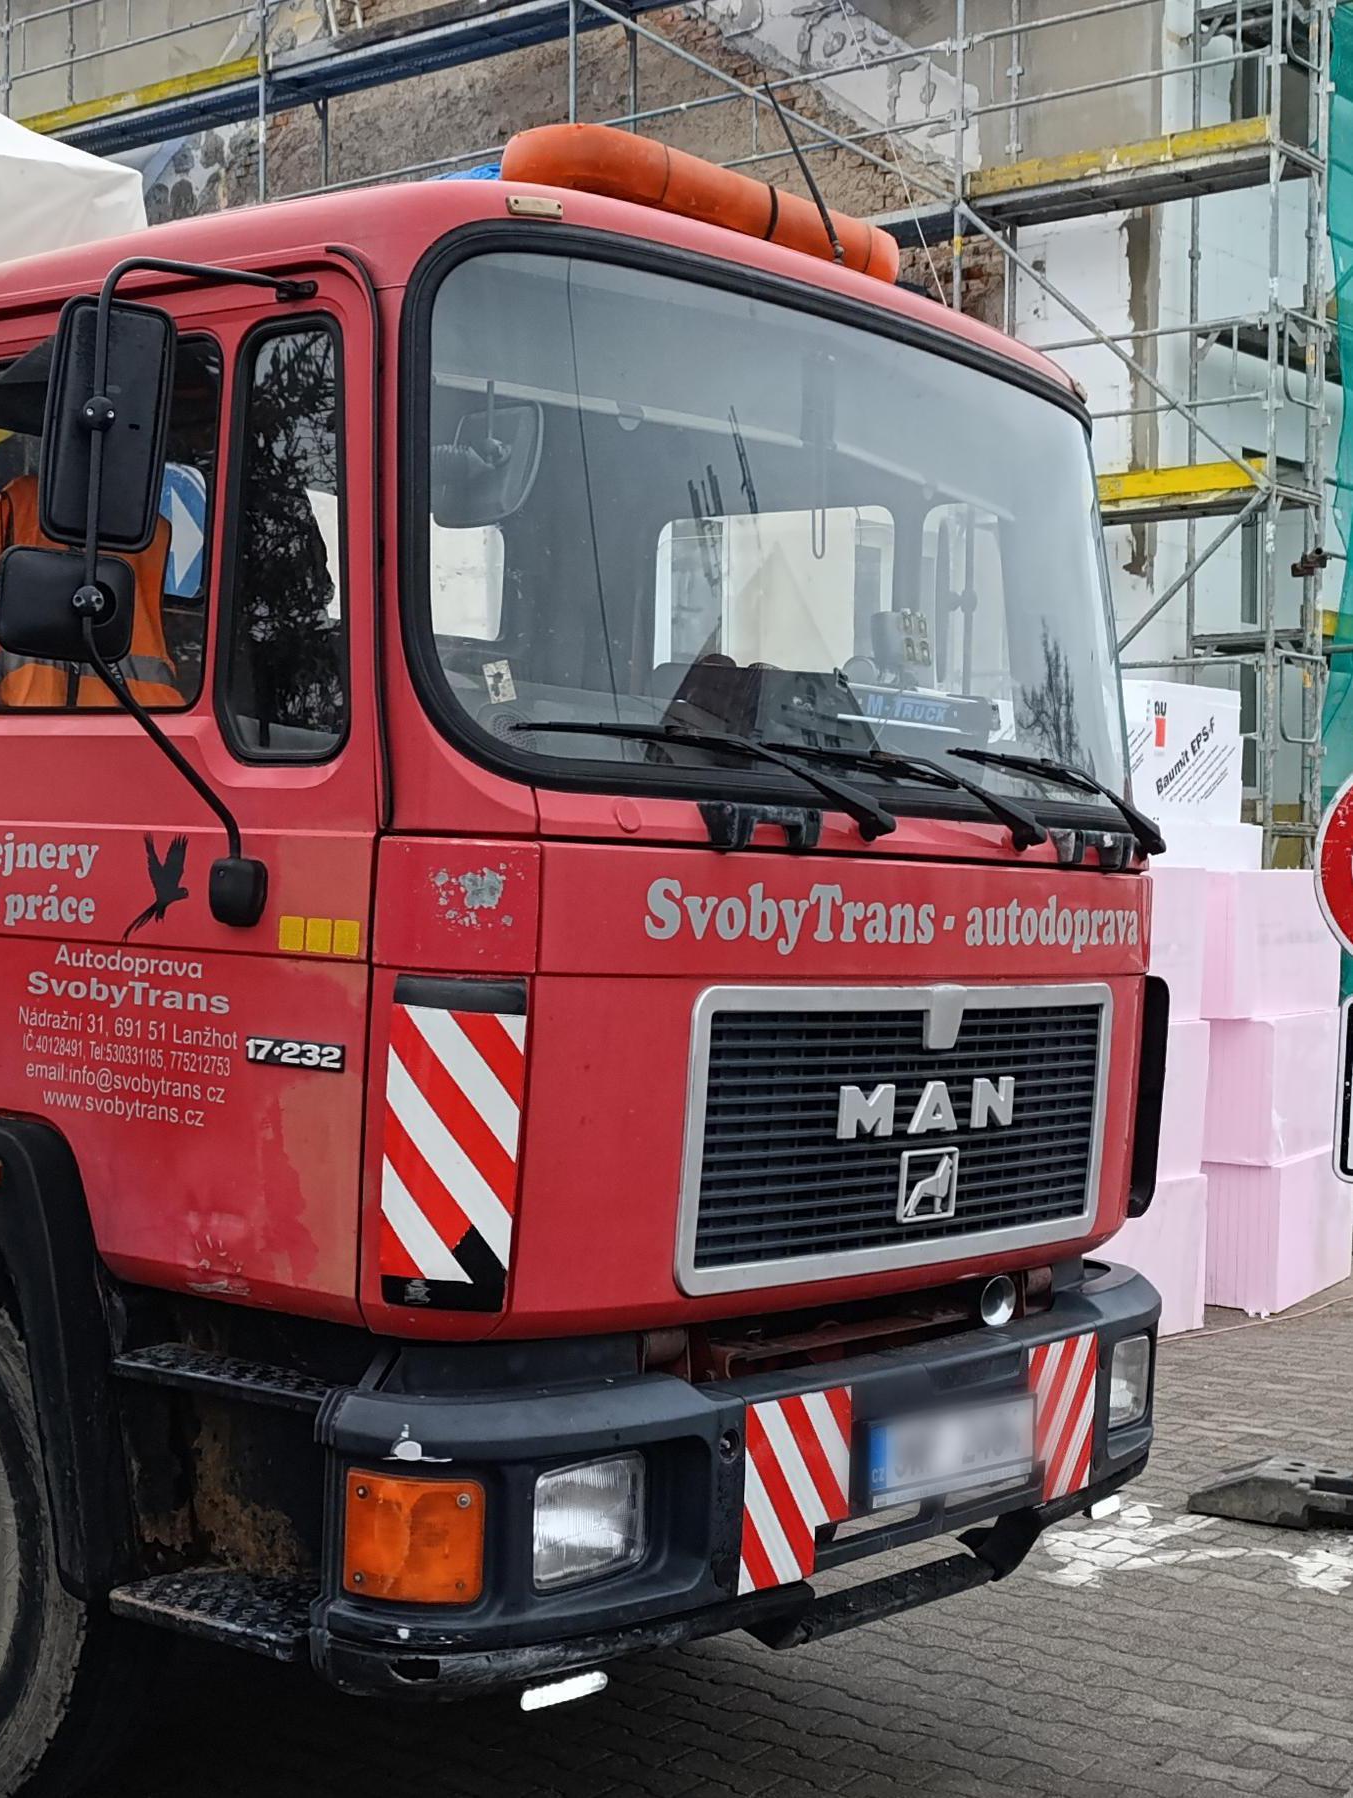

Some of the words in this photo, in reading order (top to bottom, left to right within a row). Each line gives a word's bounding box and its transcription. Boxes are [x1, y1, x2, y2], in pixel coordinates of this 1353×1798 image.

[1155, 749, 1190, 796] Baumit
[3, 884, 97, 927] práce
[644, 877, 936, 956] SvobyTrans
[964, 894, 1139, 954] autodoprava
[54, 943, 203, 979] Autodoprava
[27, 970, 231, 1015] SvobyTrans
[18, 1005, 83, 1032] Nádražní
[86, 1013, 110, 1037] 31,
[114, 1016, 142, 1039] 691
[148, 1020, 167, 1041] 51
[173, 1023, 238, 1050] Lanžhot
[25, 1061, 226, 1104] email:info@svobytrans.cz
[170, 1050, 231, 1077] 775212753
[42, 1089, 205, 1127] www.svobytrans.cz
[836, 1075, 1016, 1140] MAN
[871, 1466, 885, 1484] CZ
